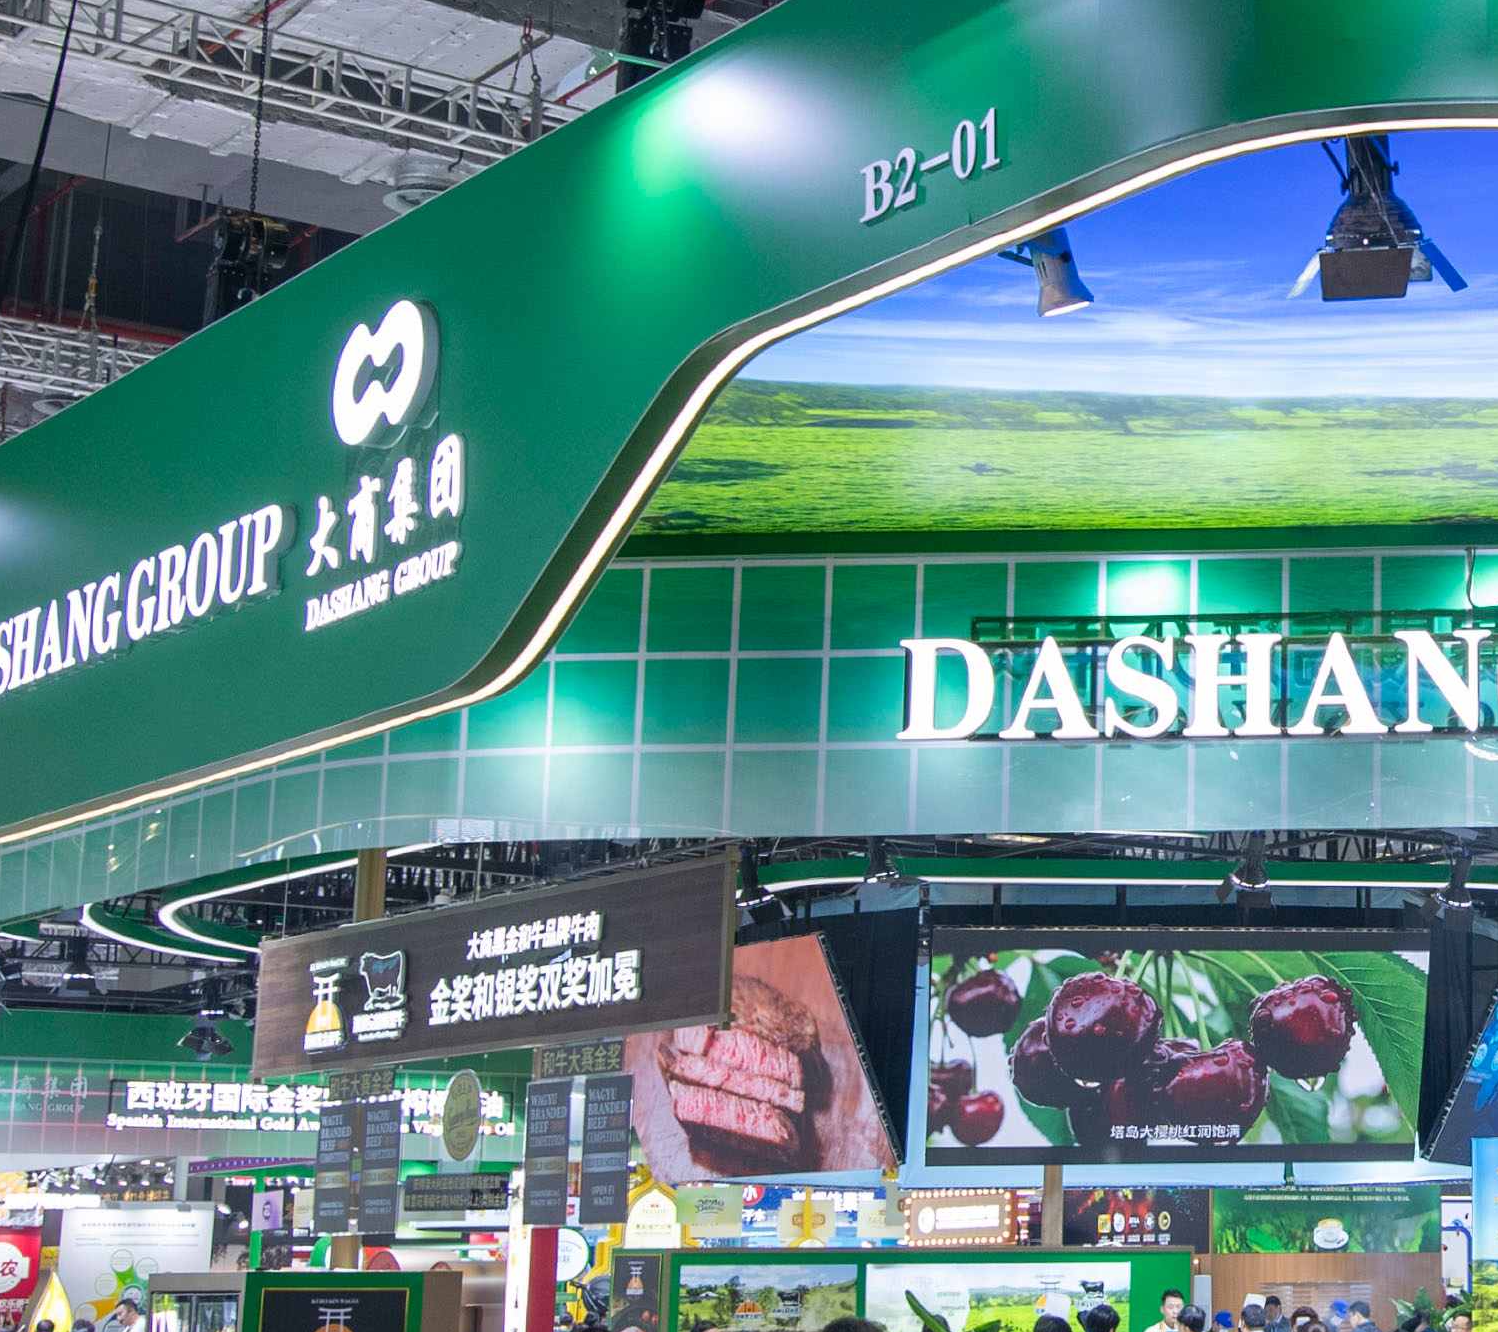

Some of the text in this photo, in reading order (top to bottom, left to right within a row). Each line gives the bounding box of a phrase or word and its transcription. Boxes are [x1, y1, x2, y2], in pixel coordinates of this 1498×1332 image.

[858, 107, 1000, 227] B2-01
[307, 432, 466, 578] 大商集团
[122, 505, 285, 645] GROUP
[306, 539, 460, 632] DASHANG GROUP
[428, 949, 643, 1027] 金奖和银奖双奖加冕
[106, 1112, 164, 1130] Spanish
[167, 1115, 258, 1132] International
[260, 1115, 295, 1132] Gold
[1109, 1123, 1242, 1140] 塔岛大樱桃红润饱满
